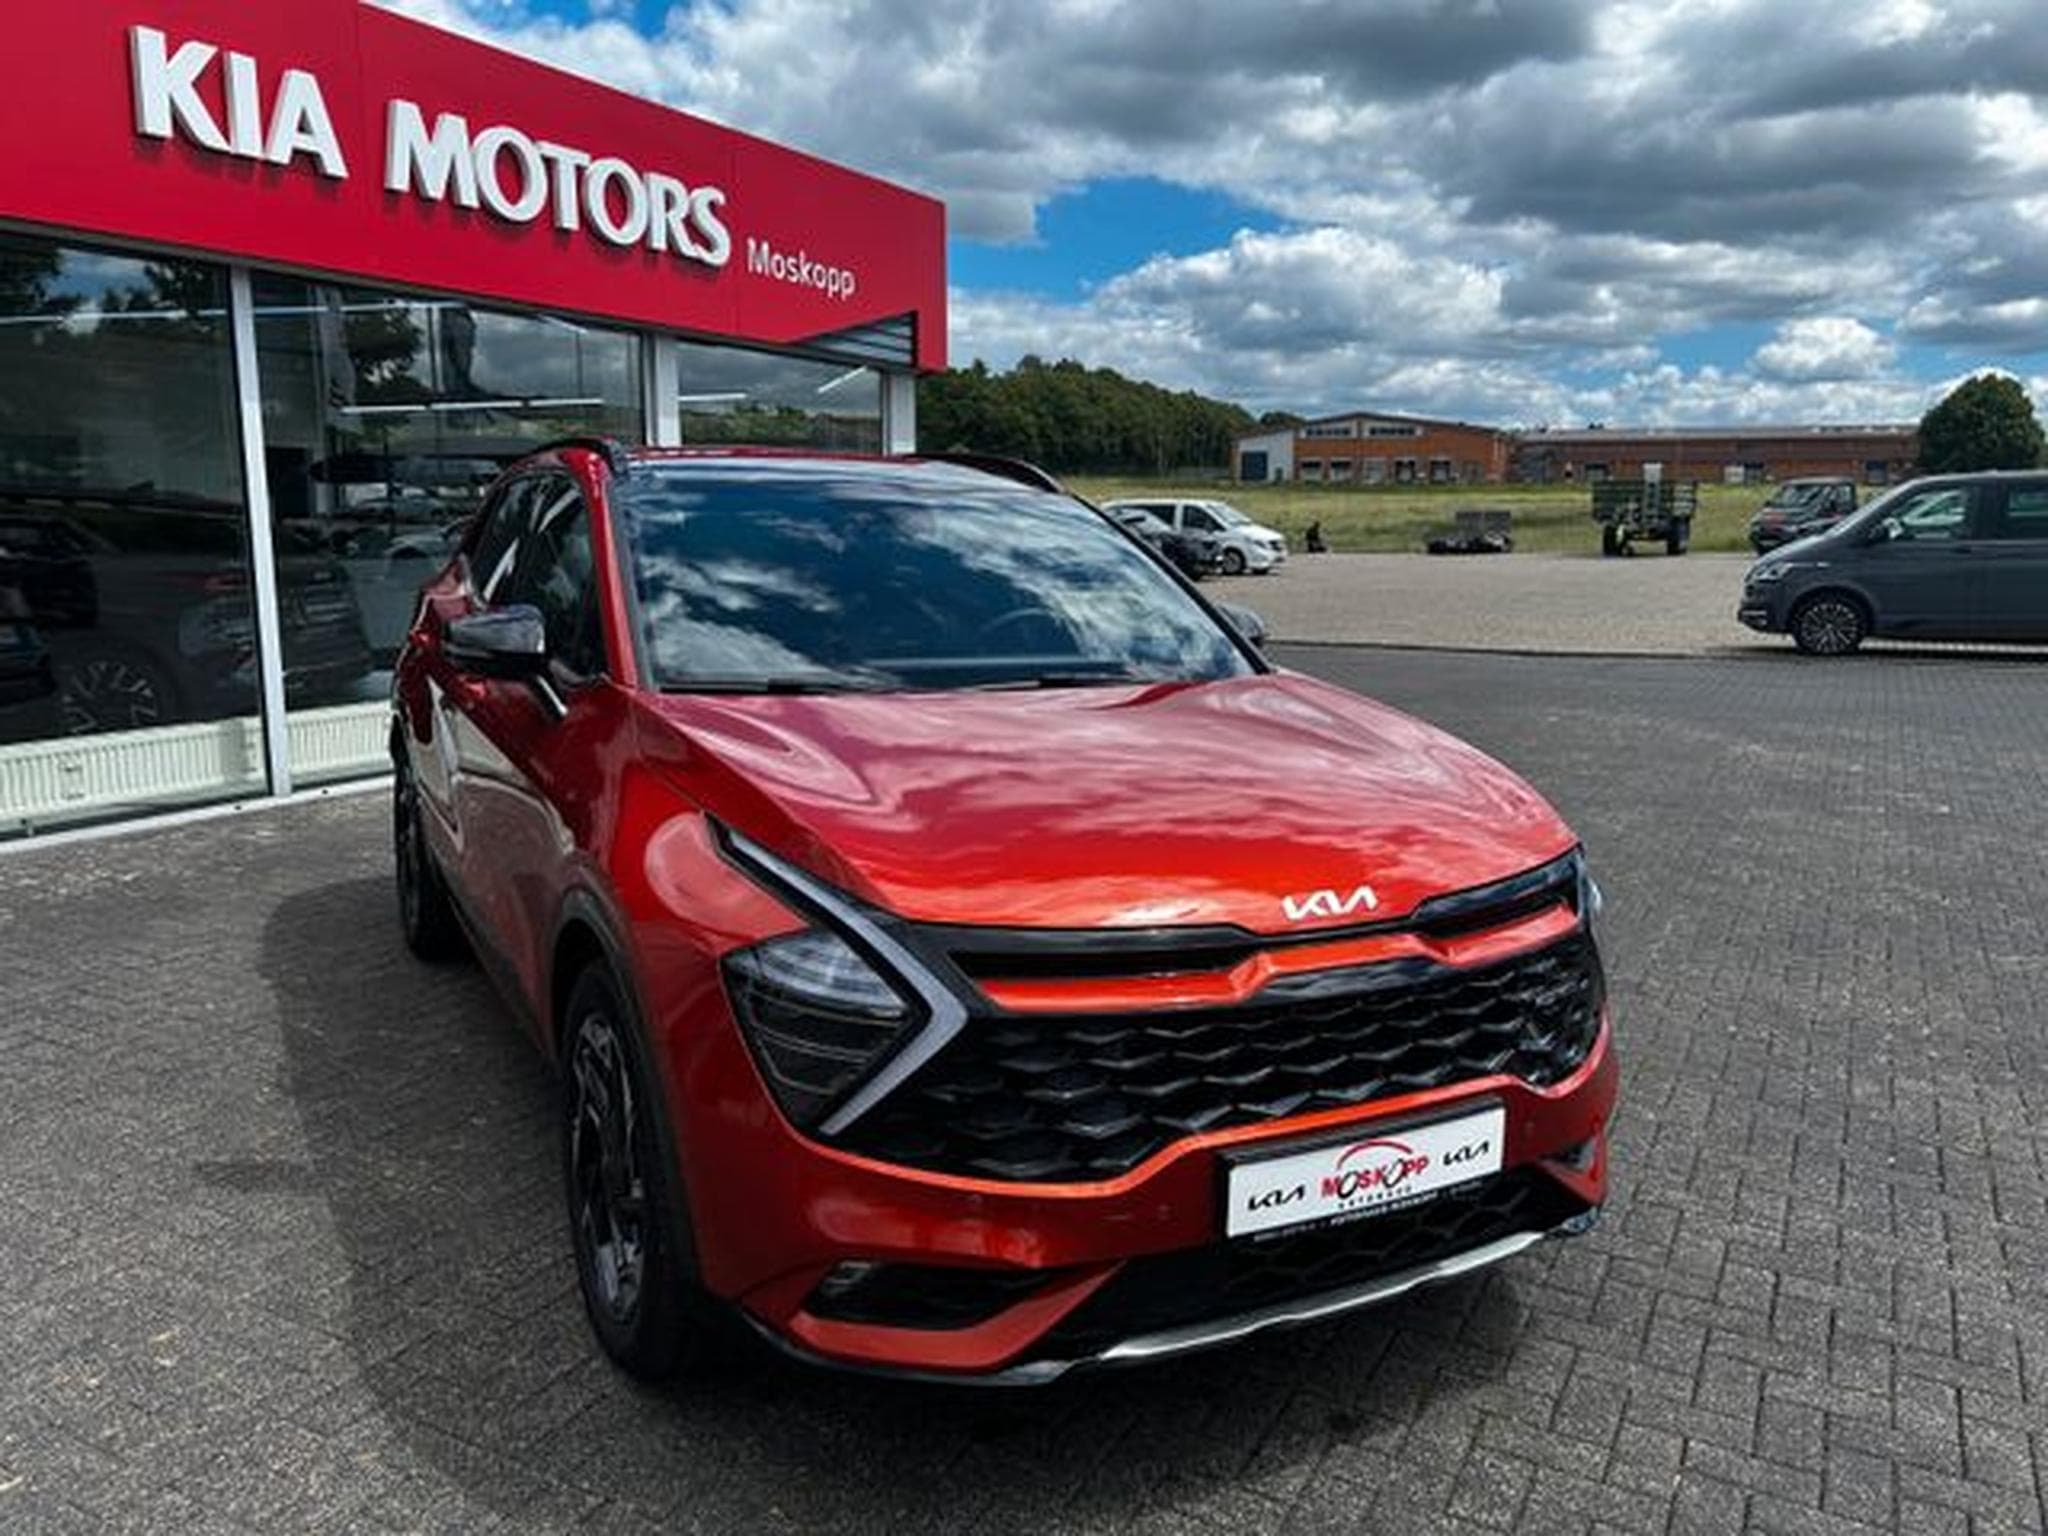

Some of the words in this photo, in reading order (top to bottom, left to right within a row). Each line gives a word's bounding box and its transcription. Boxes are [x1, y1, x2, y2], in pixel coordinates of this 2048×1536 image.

[130, 25, 348, 180] KIA
[384, 99, 731, 268] MOTORS
[747, 237, 856, 301] Moskopp
[1282, 885, 1378, 920] KIA
[1248, 1185, 1305, 1211] KIA
[1321, 1155, 1429, 1198] MOSKOPP
[1443, 1140, 1489, 1166] KIA
